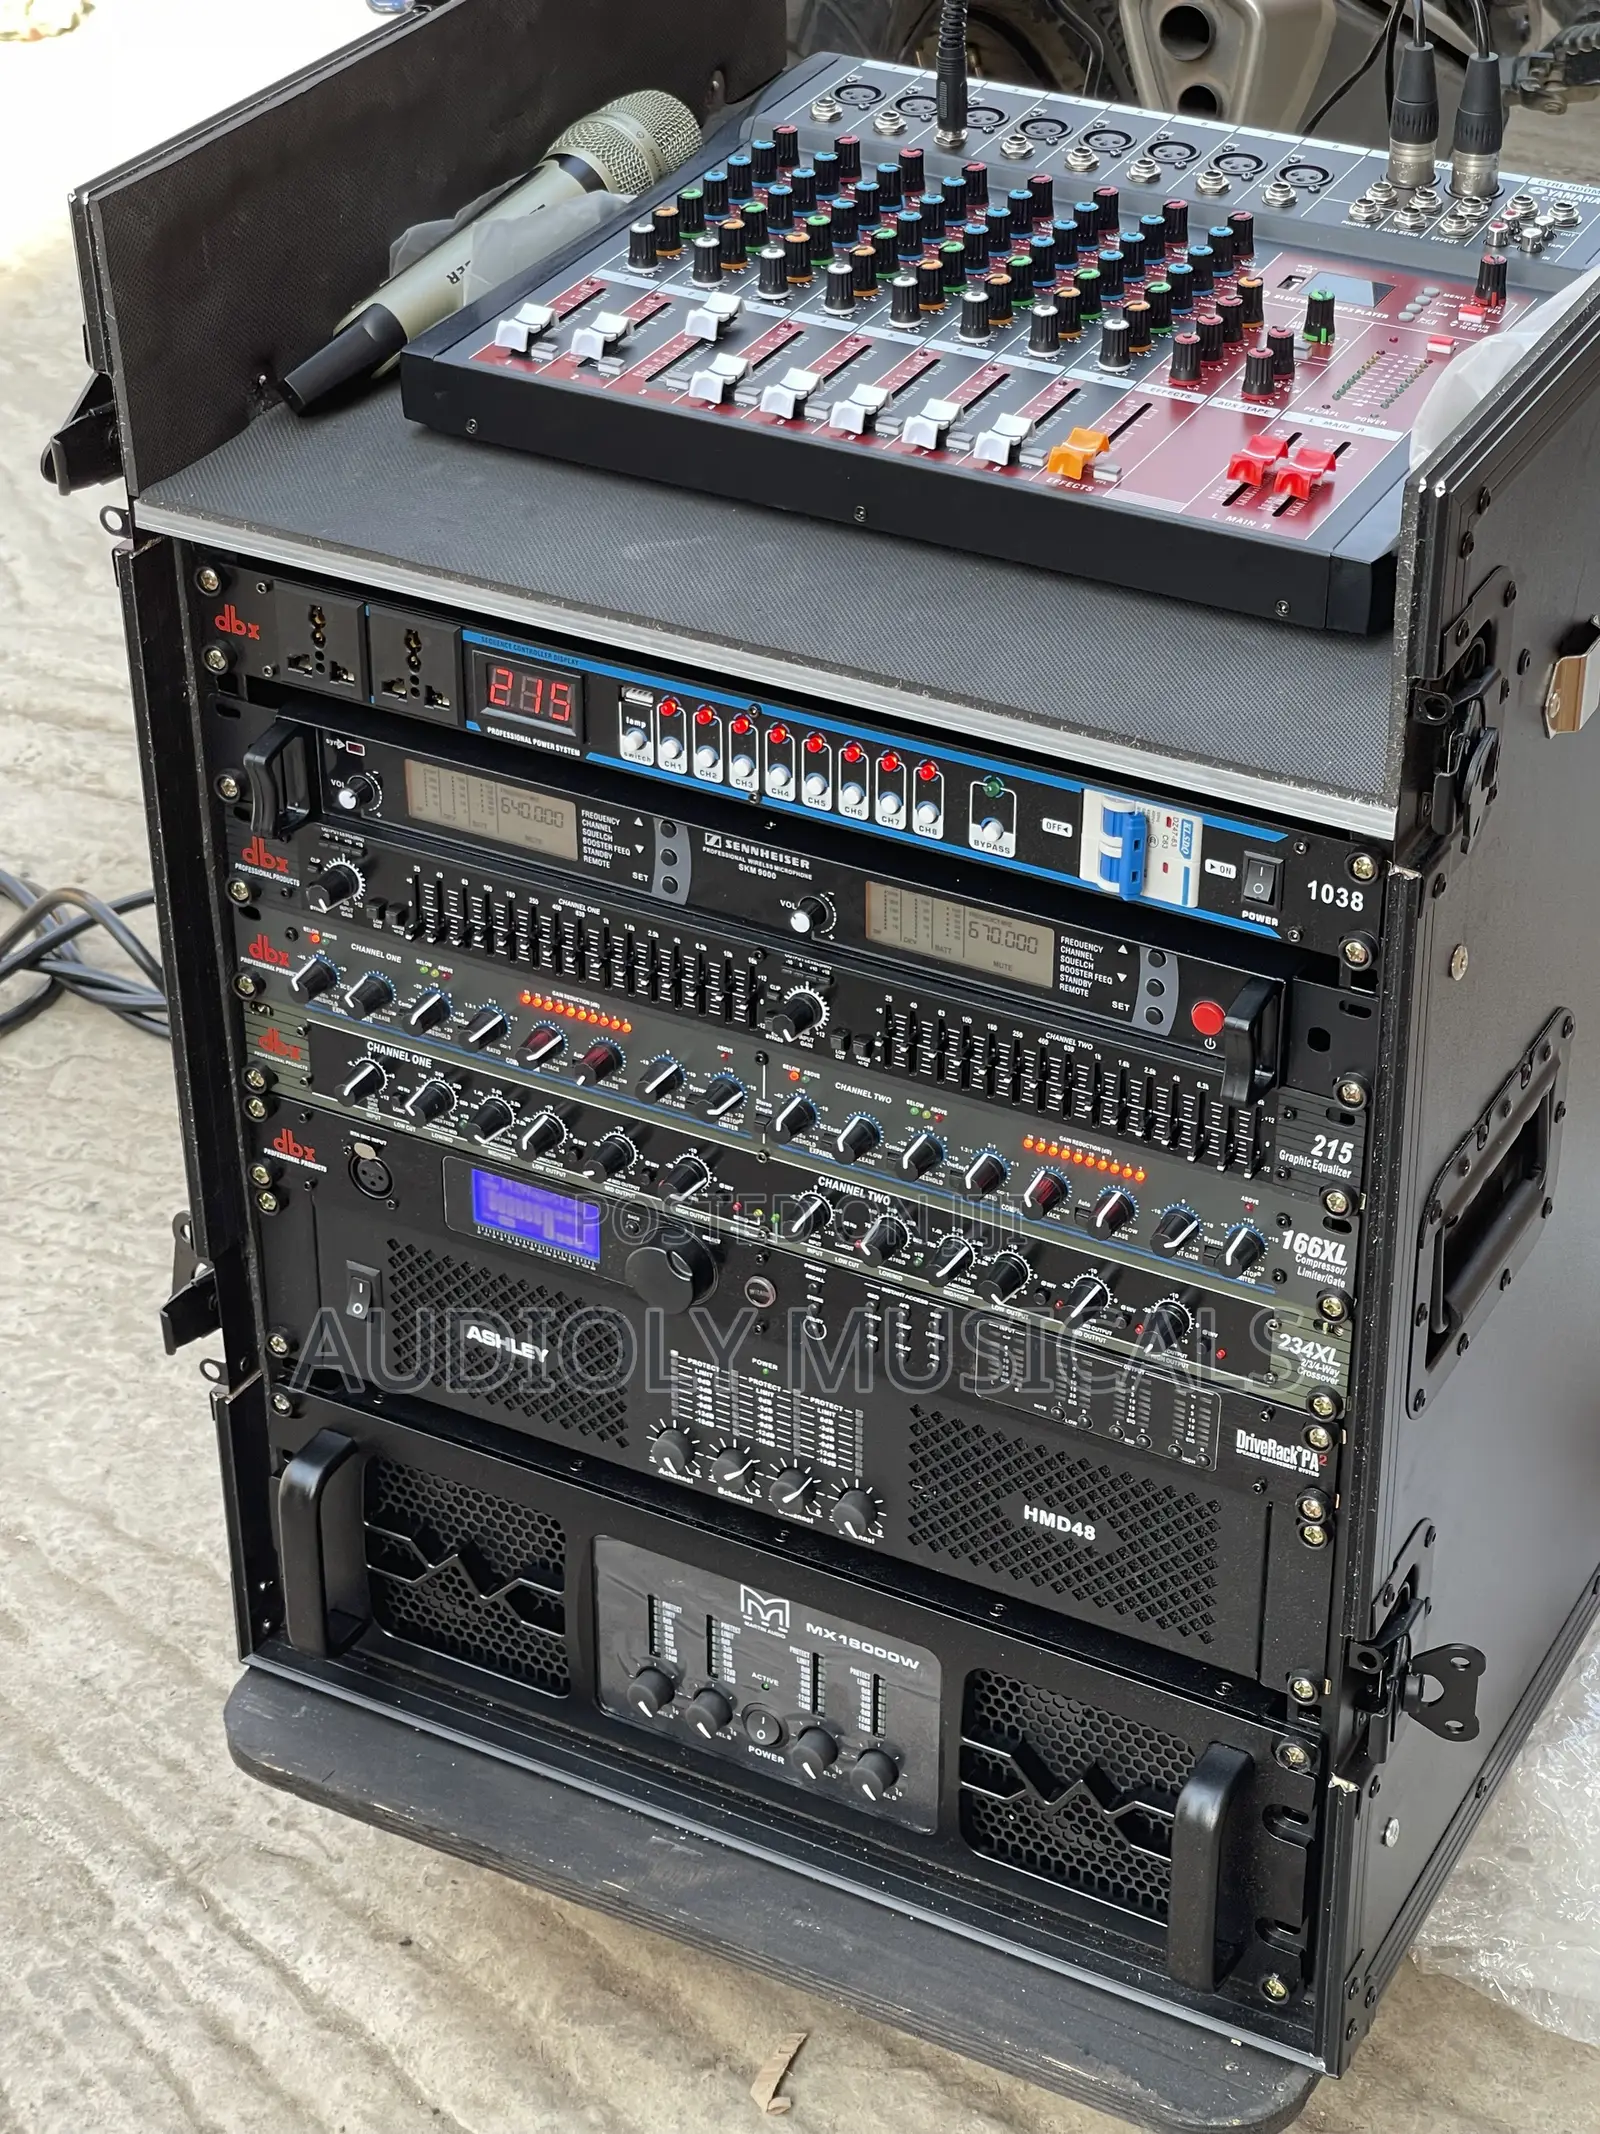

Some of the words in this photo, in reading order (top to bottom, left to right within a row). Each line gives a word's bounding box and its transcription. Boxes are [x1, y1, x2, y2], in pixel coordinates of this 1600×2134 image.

[1547, 189, 1600, 204] YAMAHA
[1341, 220, 1371, 229] PHONES
[1398, 230, 1419, 238] SEND
[1431, 236, 1460, 245] EFFECT
[1354, 309, 1389, 319] PLAYER
[1150, 387, 1192, 400] EFFECTS
[1304, 406, 1339, 417] PFL/AFL
[1354, 415, 1388, 426] POWER
[1046, 477, 1095, 493] EFFECTS
[1225, 515, 1257, 527] MAIN
[214, 604, 260, 641] dbx
[481, 636, 512, 651] SEQUENCE
[513, 643, 551, 660] CONTROLLER
[553, 653, 580, 667] DISPLAY
[489, 668, 571, 722] 215
[487, 725, 532, 745] PROFESSIONAL
[532, 737, 555, 752] POWER
[555, 744, 581, 757] SYSTEM
[623, 751, 652, 763] switch
[664, 760, 682, 770] CH1
[699, 769, 717, 779] CH2
[735, 778, 754, 788] CH3
[771, 787, 790, 797] CH4
[808, 796, 826, 807] CH5
[500, 797, 564, 829] 640.000
[581, 809, 620, 826] FREQUENCY
[844, 806, 863, 817] CH6
[582, 819, 613, 834] CHANNEL
[881, 815, 900, 826] CH7
[1046, 821, 1064, 832] OFF
[582, 828, 613, 842] SQUELCH
[918, 825, 937, 835] CH8
[582, 837, 613, 851] BOOSTER
[973, 838, 1011, 855] BYPASS
[241, 836, 289, 873] dbx
[583, 846, 613, 860] STANDBY
[725, 839, 810, 869] SENNHEISER
[583, 855, 611, 869] REMOTE
[702, 846, 746, 863] PROFESSIONAL
[773, 865, 813, 880] MICROPHONE
[234, 862, 273, 881] PROFESSIONAL
[272, 872, 300, 887] PRODUCTS
[632, 871, 649, 882] SET
[738, 863, 757, 875] SKM
[757, 868, 777, 880] 9000
[1219, 865, 1232, 875] ON
[1307, 879, 1365, 913] 1038
[558, 897, 586, 912] CHANNEL
[586, 905, 601, 915] ONE
[780, 899, 798, 911] VOL
[1242, 910, 1279, 927] POWER
[968, 920, 1038, 955] 670.000
[1060, 936, 1104, 954] FREQUENCY
[248, 933, 291, 968] dbx
[351, 943, 385, 959] CHANNEL
[386, 953, 401, 963] ONE
[1060, 946, 1094, 961] CHANNEL
[240, 956, 276, 974] PROFESSIONAL
[1060, 955, 1094, 970] SQUELCH
[1060, 964, 1093, 980] BOOSTER
[1060, 974, 1093, 989] STANDBY
[1059, 983, 1089, 998] REMOTE
[1111, 1000, 1130, 1012] SET
[258, 1027, 301, 1060] dbx
[1045, 1031, 1076, 1047] CHANNEL
[1077, 1041, 1094, 1051] TWO
[366, 1041, 411, 1063] CHANNEL
[411, 1054, 433, 1069] ONE
[717, 1045, 733, 1054] ABOVE
[254, 1050, 285, 1066] PROFESSIONAL
[285, 1059, 308, 1071] PRODUCTS
[782, 1063, 800, 1072] BELOW
[804, 1070, 821, 1079] ABOVE
[835, 1082, 873, 1099] CHANNEL
[873, 1093, 892, 1104] TWO
[756, 1099, 772, 1108] Stereo
[906, 1099, 924, 1108] BELOW
[930, 1106, 948, 1116] ABOVE
[273, 1128, 316, 1163] dbx
[1059, 1135, 1071, 1144] GAIN
[1071, 1138, 1101, 1152] REDUCTION
[1310, 1134, 1355, 1164] 215
[264, 1147, 300, 1166] PROFESSIONAL
[300, 1158, 327, 1173] PRODUCTS
[1279, 1149, 1311, 1170] Graphic
[1311, 1158, 1353, 1180] Equalizer
[532, 1163, 544, 1171] LOW
[545, 1167, 567, 1178] OUTPUT
[615, 1188, 636, 1200] OUTPUT
[817, 1176, 866, 1198] CHANNEL
[867, 1190, 891, 1206] TWO
[1077, 1199, 1091, 1208] Auto
[1241, 1196, 1260, 1206] ABOVE
[689, 1211, 711, 1223] OUTPUT
[1203, 1235, 1223, 1247] Bypass
[1282, 1229, 1348, 1267] 166XL
[834, 1256, 848, 1266] LOW
[848, 1260, 860, 1269] CUT
[1184, 1251, 1199, 1261] GAIN
[1295, 1254, 1348, 1276] Compressor/
[1297, 1266, 1346, 1289] Limiter/Gate
[991, 1304, 1005, 1313] LOW
[1006, 1307, 1030, 1320] OUTPUT
[466, 1324, 549, 1363] ASHLEY
[1083, 1332, 1107, 1344] OUTPUT
[1278, 1334, 1342, 1368] 234XL
[687, 1357, 720, 1373] PROTECT
[751, 1357, 779, 1371] POWER
[1123, 1364, 1145, 1375] OUTPUT
[1165, 1357, 1190, 1370] OUTPUT
[1300, 1358, 1341, 1376] 2/3/4-Way
[694, 1369, 713, 1379] LIMIT
[1297, 1367, 1340, 1386] Crossover
[748, 1376, 782, 1393] PROTECT
[755, 1387, 775, 1399] LIMIT
[809, 1396, 844, 1412] PROTECT
[816, 1407, 837, 1418] LIMIT
[1236, 1429, 1300, 1466] DriveRack
[1023, 1504, 1097, 1542] HMD48
[720, 1622, 741, 1634] PROTECT
[744, 1621, 767, 1633] MARTIN
[789, 1645, 811, 1659] PROTECT
[806, 1622, 920, 1670] MX18000W
[751, 1672, 779, 1687] ACTIVE
[849, 1666, 871, 1680] PROTECT
[748, 1745, 785, 1765] POWER
